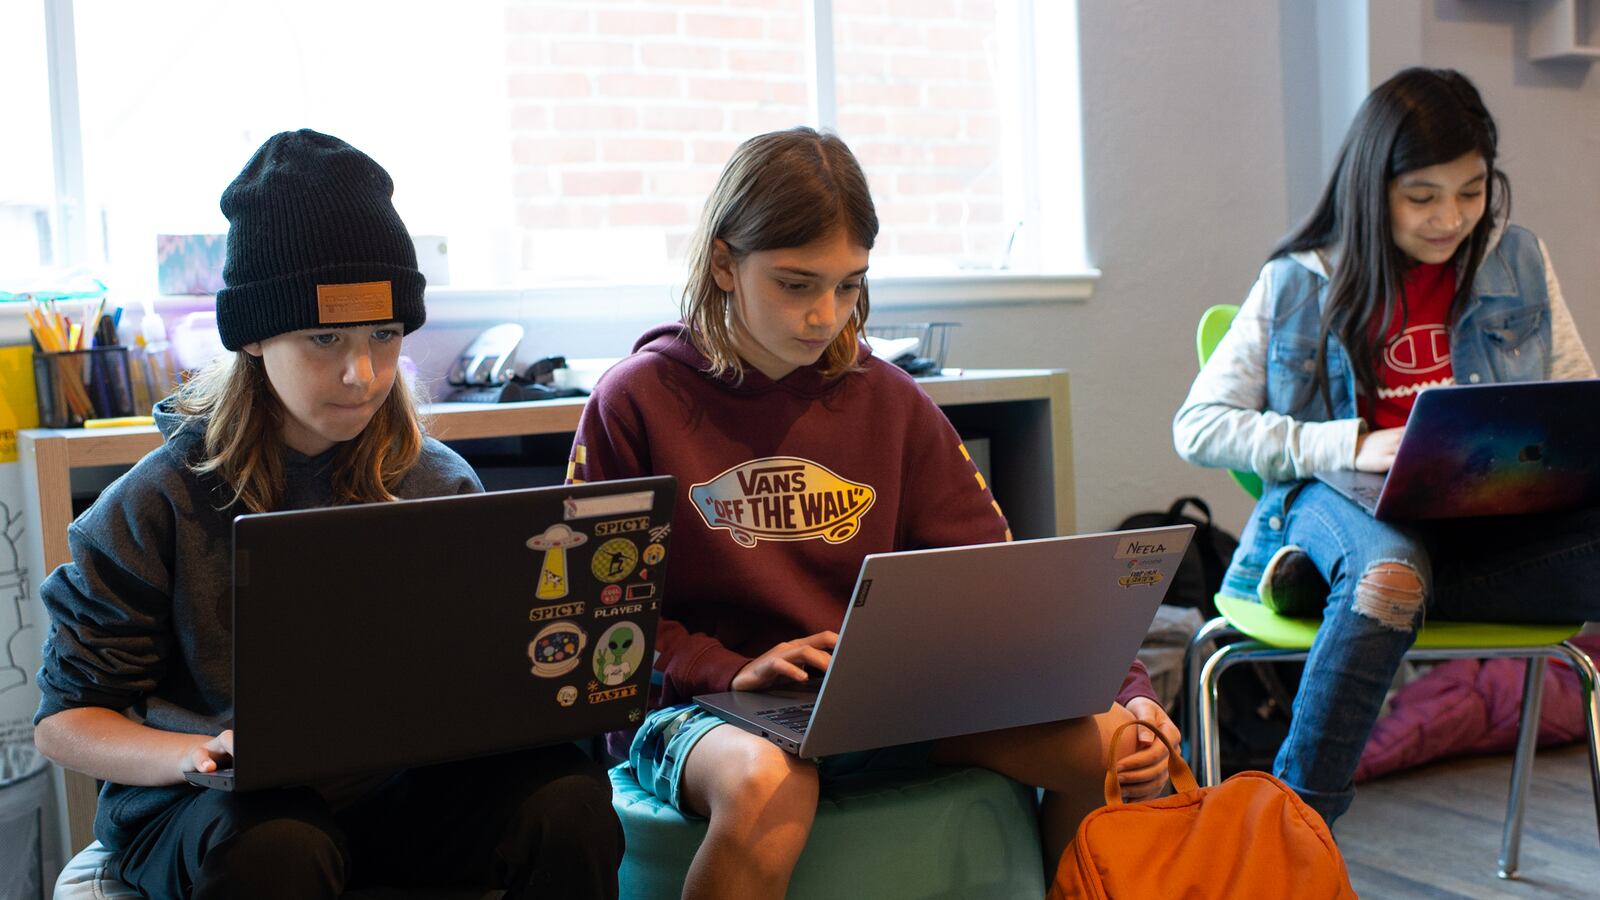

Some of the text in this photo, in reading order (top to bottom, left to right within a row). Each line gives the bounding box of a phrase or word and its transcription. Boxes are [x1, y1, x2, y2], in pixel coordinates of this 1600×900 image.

[747, 496, 797, 529] THE
[596, 517, 650, 536] SPICY!
[1126, 541, 1167, 555] NEELA
[530, 602, 584, 620] SPICY!
[594, 602, 657, 618] PLAYER 1
